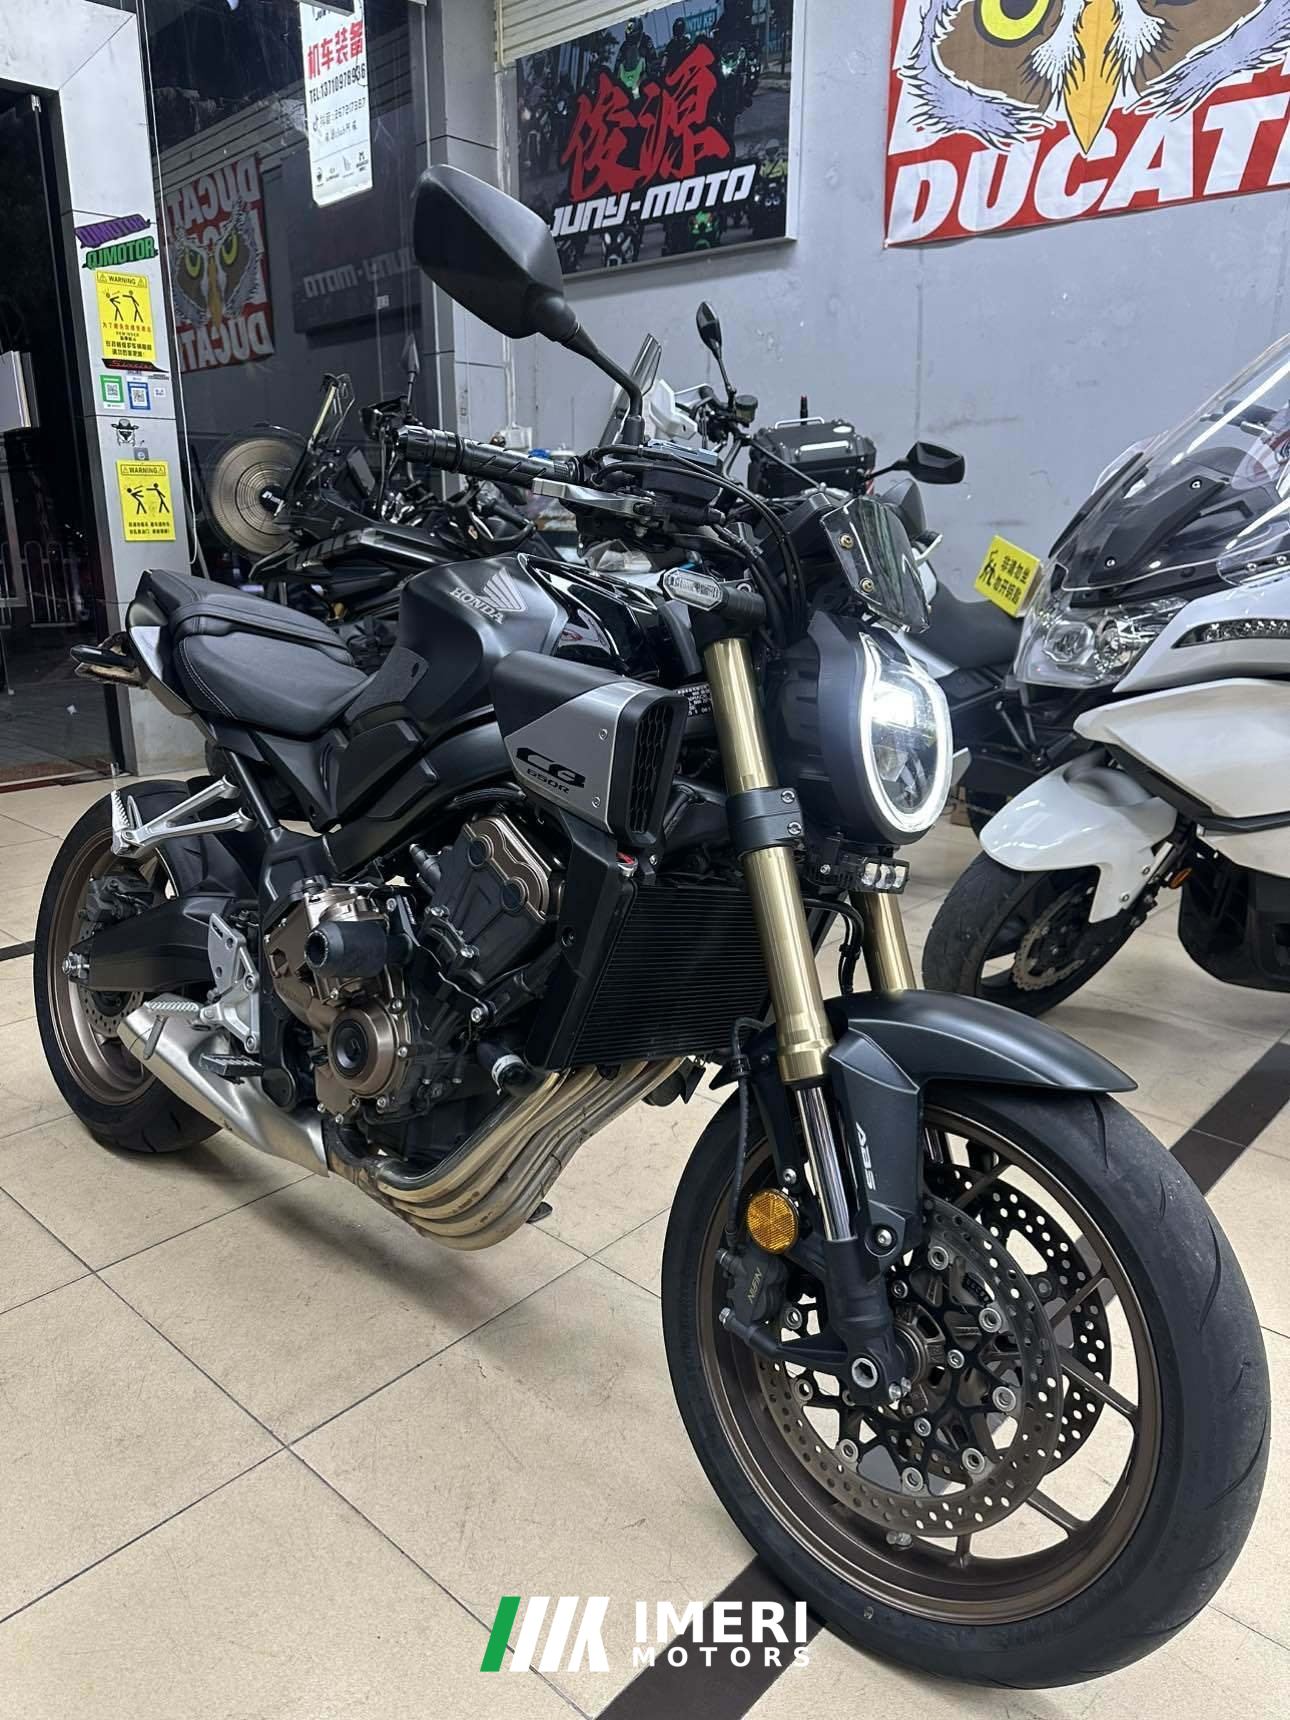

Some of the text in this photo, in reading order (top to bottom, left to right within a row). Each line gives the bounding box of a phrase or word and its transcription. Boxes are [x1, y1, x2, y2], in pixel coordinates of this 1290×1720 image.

[86, 236, 155, 268] QJMOTOR
[108, 275, 136, 285] WARNING
[129, 466, 158, 474] WARNING
[449, 587, 504, 625] HONDA
[516, 747, 586, 788] CB
[527, 768, 570, 794] 650R
[855, 1121, 876, 1191] ABS
